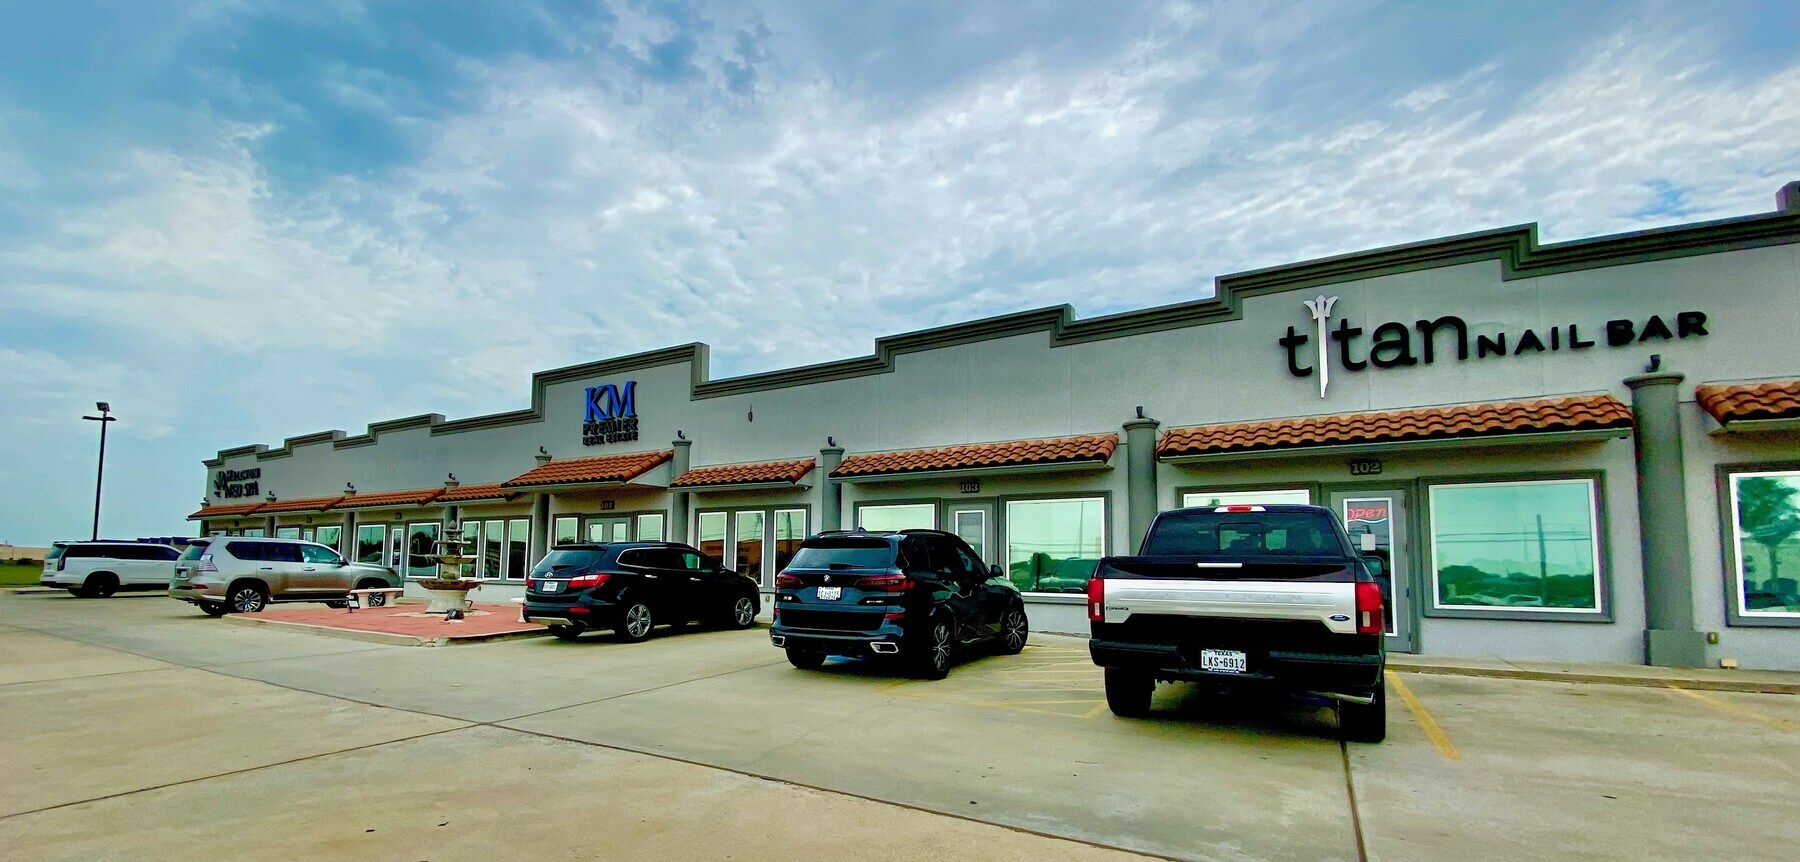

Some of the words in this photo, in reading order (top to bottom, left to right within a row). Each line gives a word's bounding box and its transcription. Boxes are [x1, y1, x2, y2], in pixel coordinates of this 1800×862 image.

[1477, 324, 1595, 358] NAIL
[1606, 311, 1709, 346] BAR
[584, 380, 637, 422] KM
[583, 417, 639, 436] PREMIER
[583, 436, 606, 446] REAL
[606, 430, 639, 443] ESTATE
[1352, 461, 1381, 474] 102
[960, 483, 979, 492] 103
[1203, 656, 1245, 668] LKS-6912
